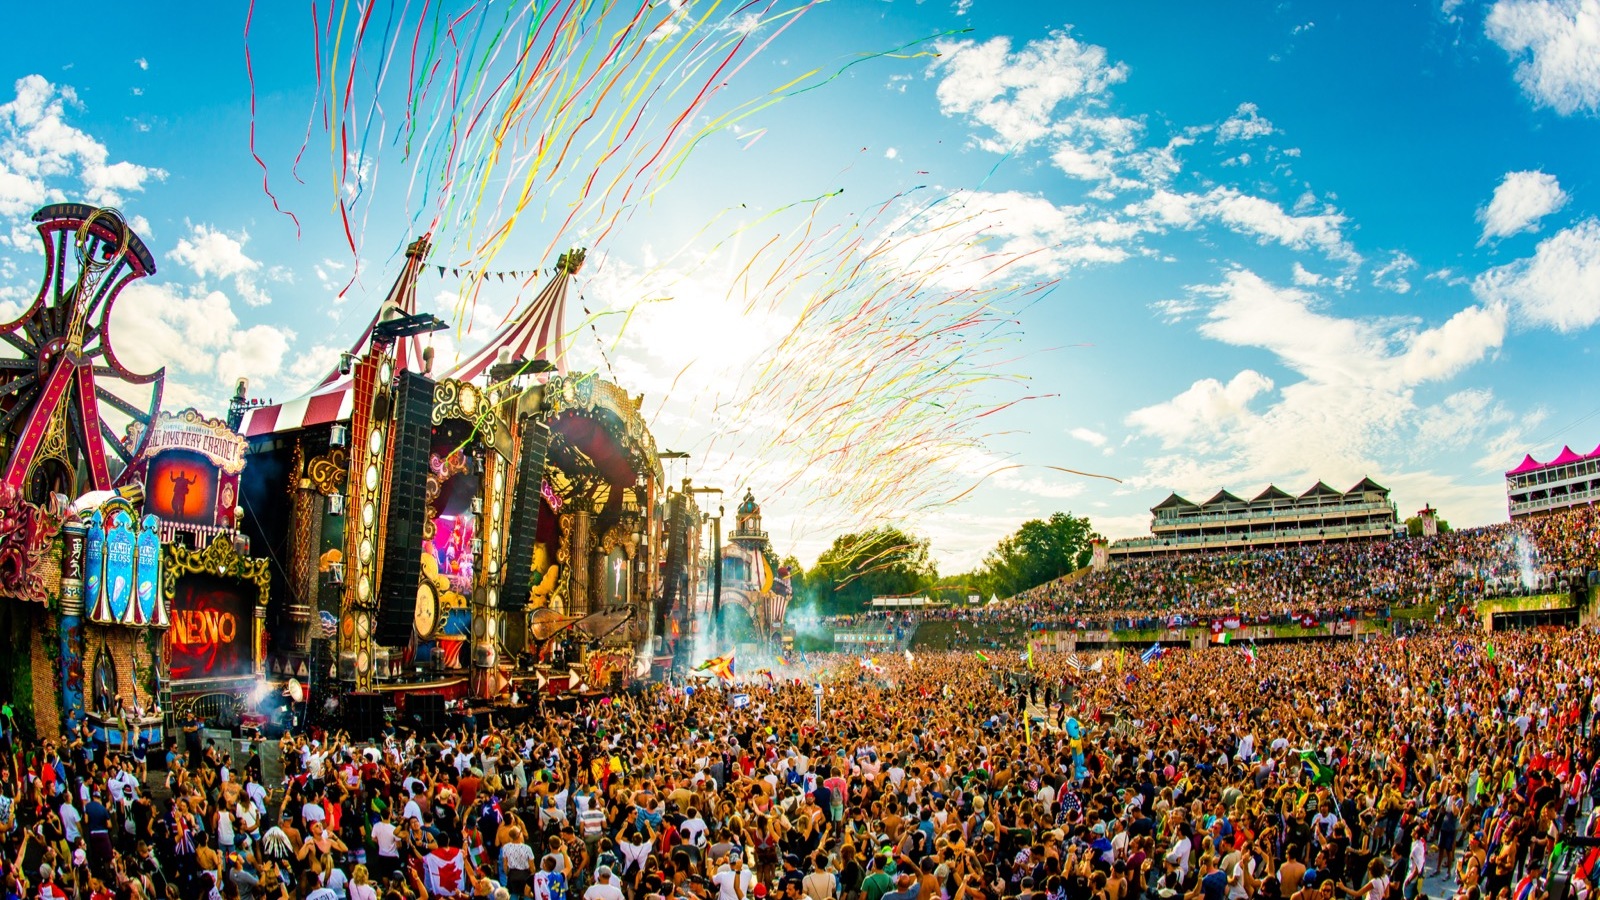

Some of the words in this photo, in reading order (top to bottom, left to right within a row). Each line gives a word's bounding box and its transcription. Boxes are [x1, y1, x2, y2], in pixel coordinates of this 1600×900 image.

[161, 430, 202, 448] MYSTERY
[202, 434, 239, 461] CABINET
[109, 542, 132, 555] CANDY
[109, 552, 131, 563] FLOSS
[171, 609, 236, 643] NERVO
